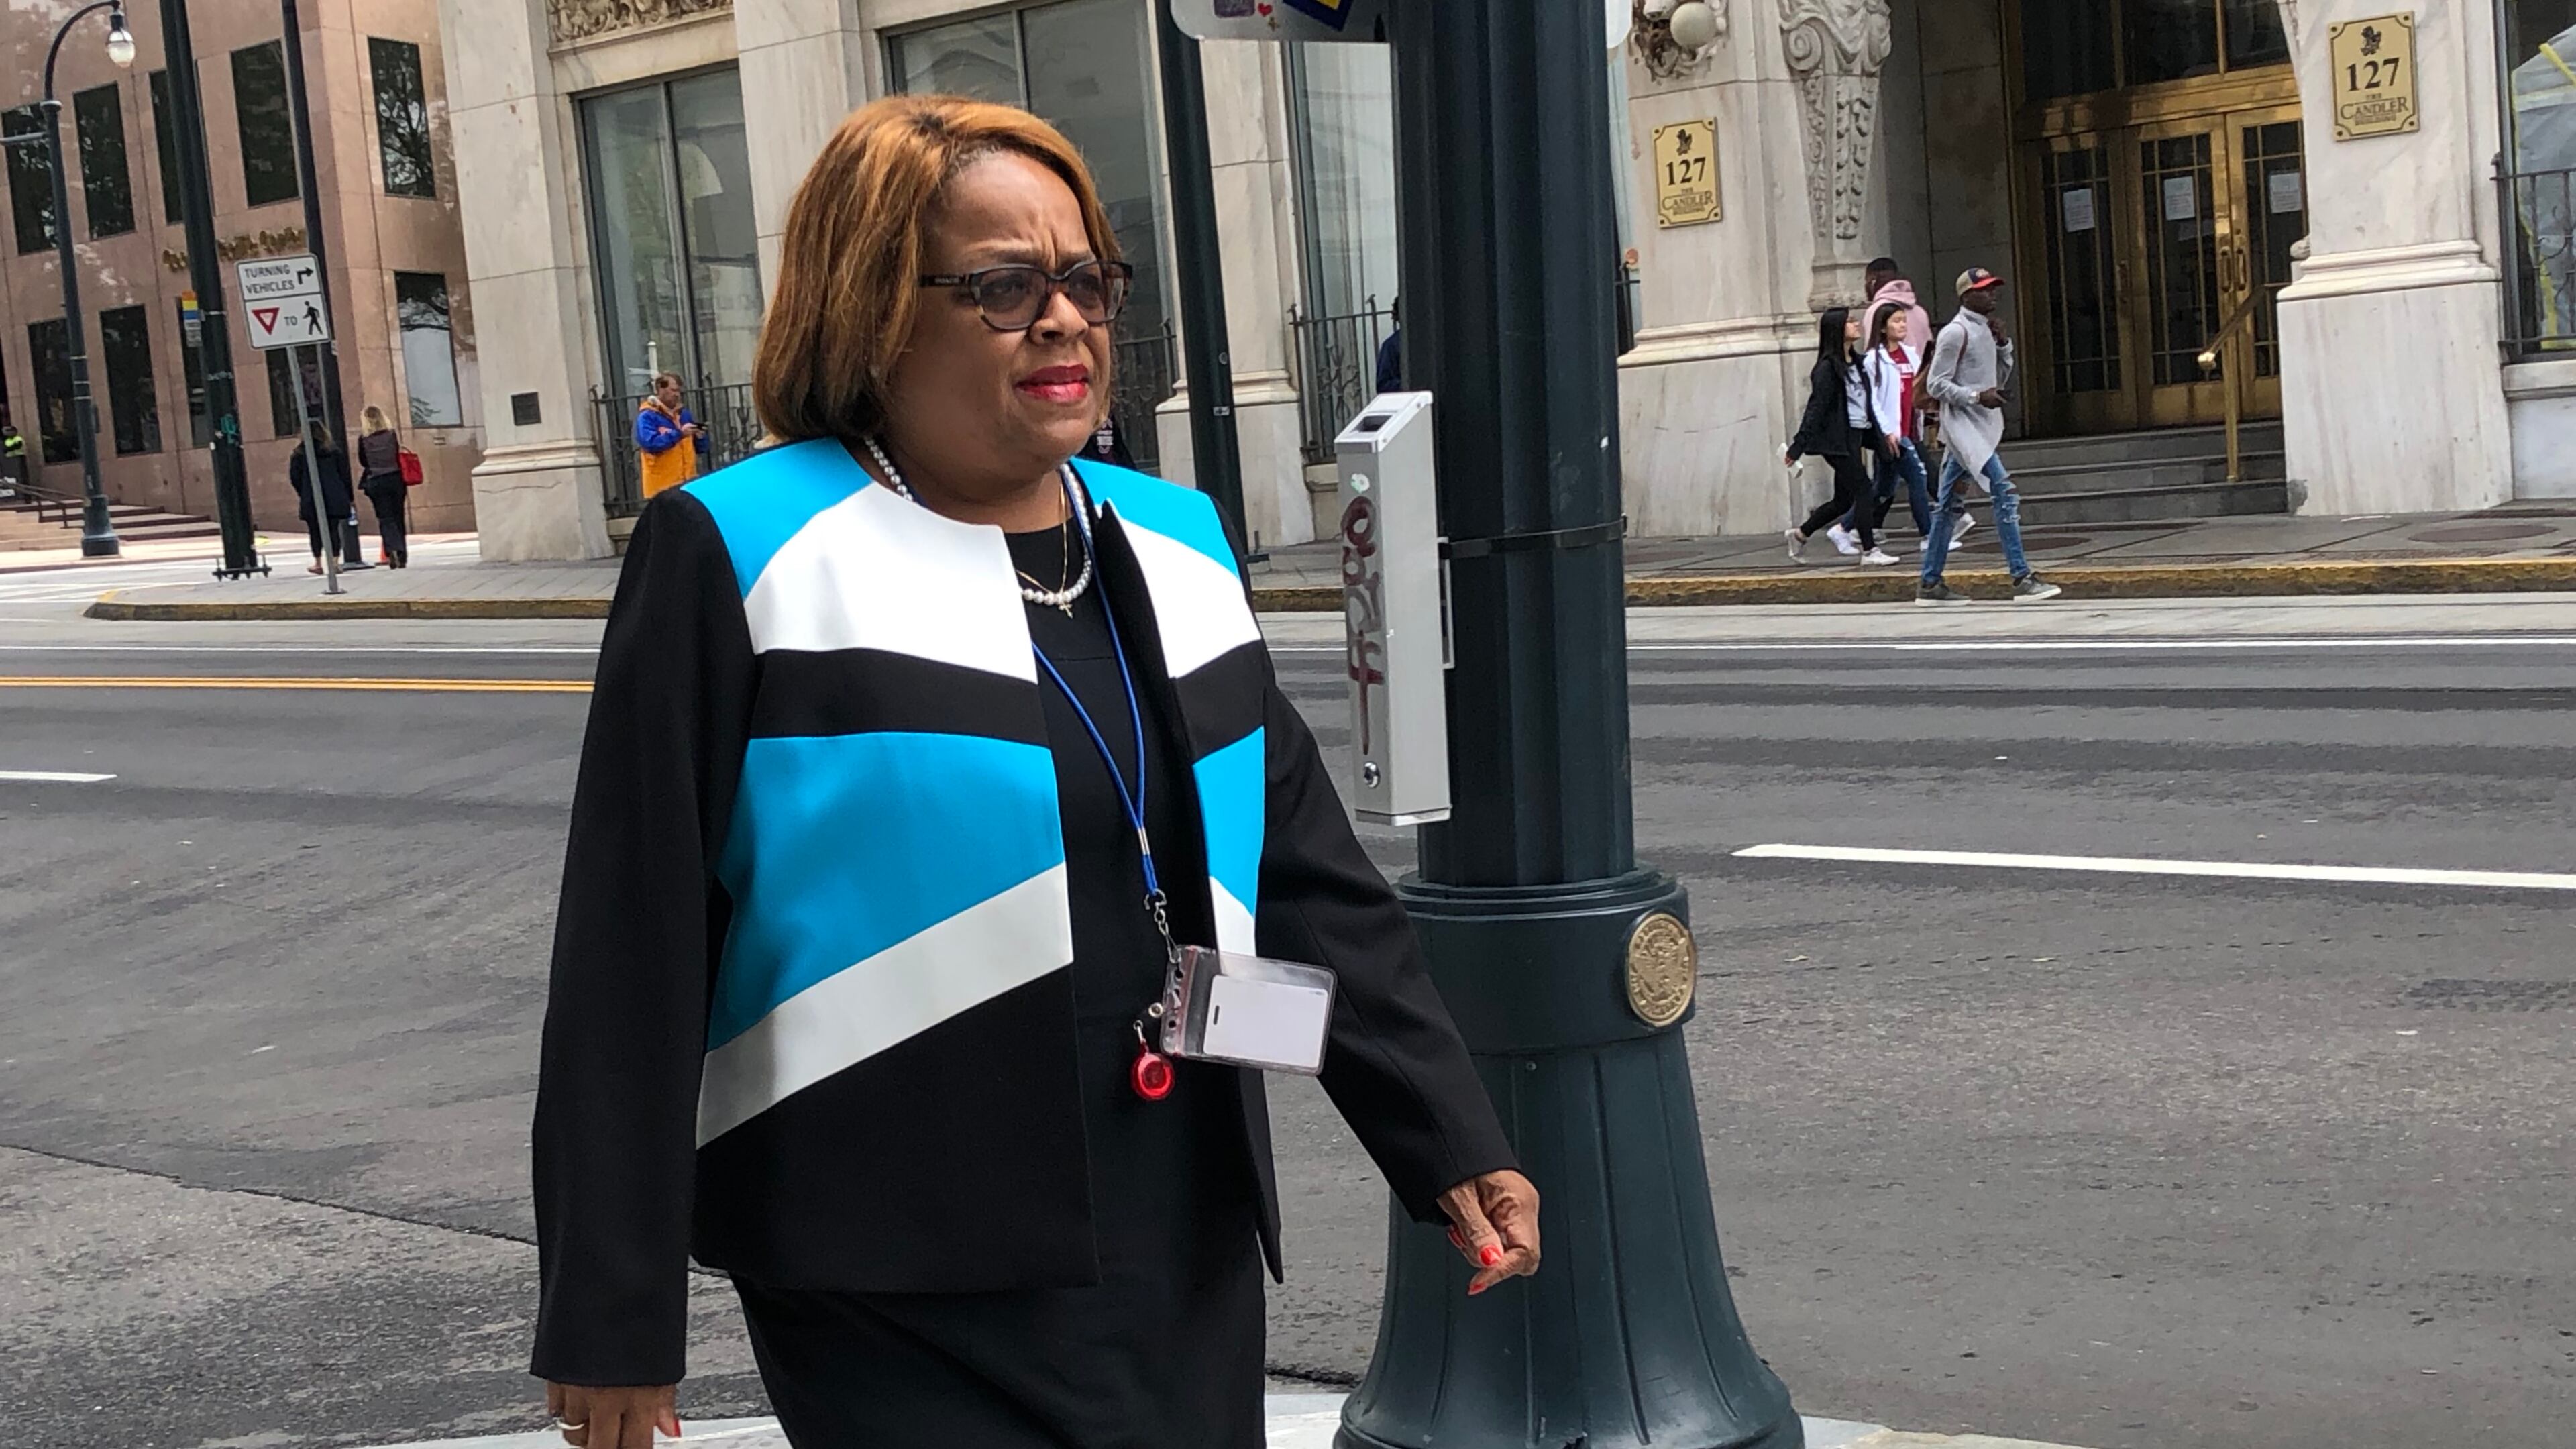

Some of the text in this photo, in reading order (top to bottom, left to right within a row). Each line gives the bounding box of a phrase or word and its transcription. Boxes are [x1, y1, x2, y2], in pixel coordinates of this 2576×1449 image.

[2346, 57, 2400, 92] 127
[2340, 96, 2409, 120] CANDLER
[1666, 157, 1706, 186] 127
[1662, 189, 1713, 211] CANDLER
[244, 264, 290, 278] TURNING
[246, 280, 295, 294] VEHICLES
[284, 315, 298, 326] TO
